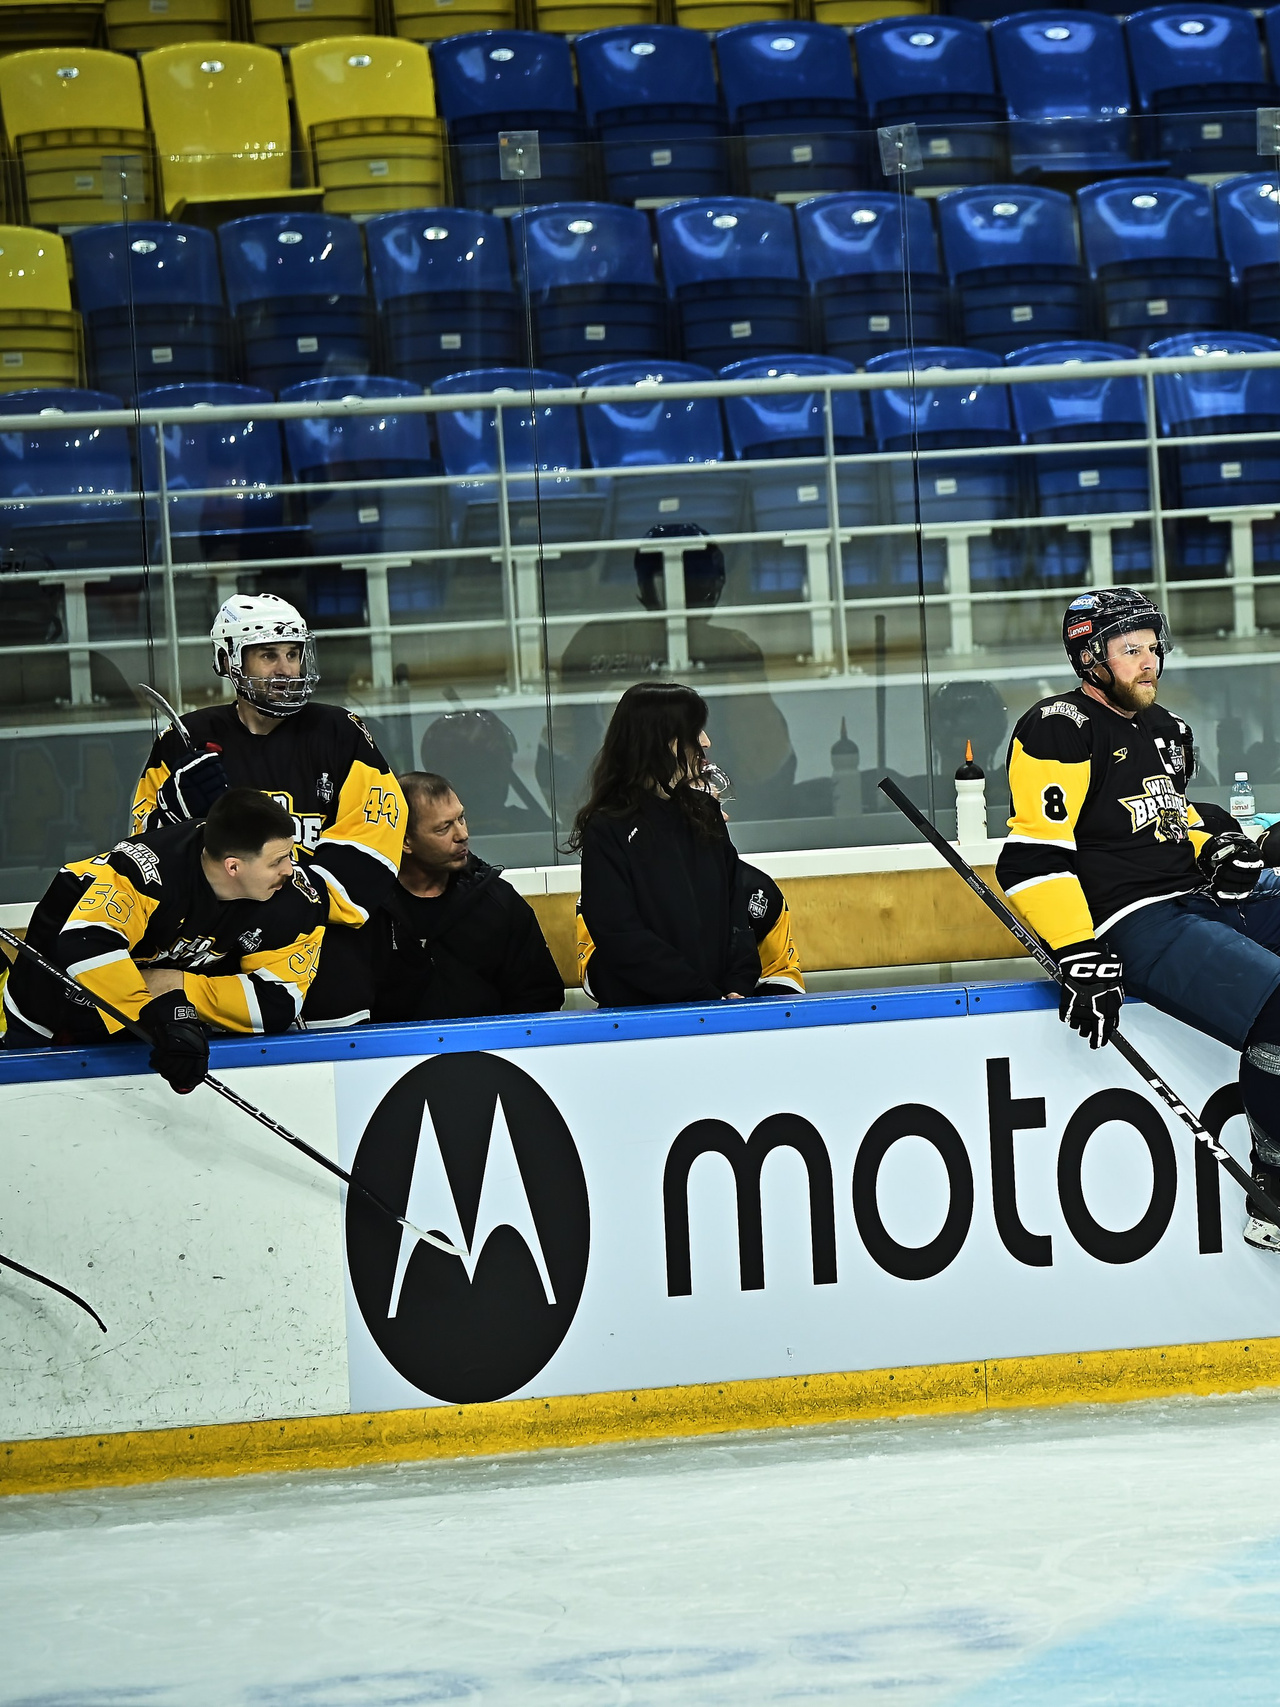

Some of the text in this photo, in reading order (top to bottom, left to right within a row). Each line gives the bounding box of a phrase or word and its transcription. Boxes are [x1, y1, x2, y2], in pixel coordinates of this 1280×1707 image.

[1069, 625, 1090, 637] Lenovo
[1153, 737, 1177, 776] C
[363, 786, 400, 830] 44
[1043, 785, 1069, 822] 8
[77, 883, 136, 925] 55
[1069, 962, 1123, 978] CC
